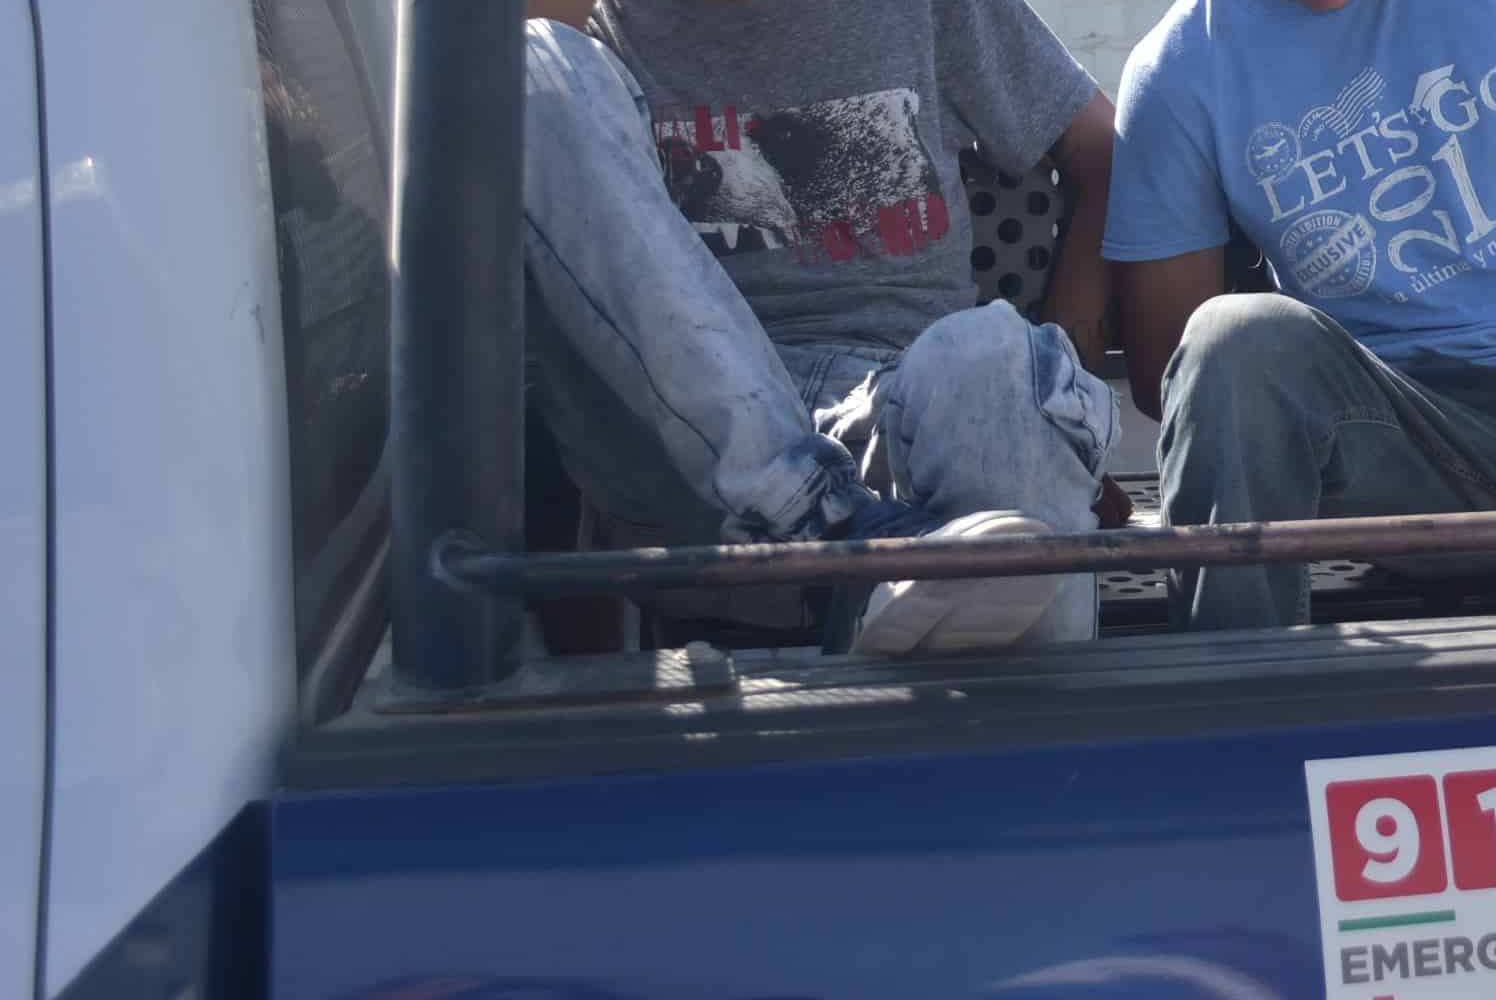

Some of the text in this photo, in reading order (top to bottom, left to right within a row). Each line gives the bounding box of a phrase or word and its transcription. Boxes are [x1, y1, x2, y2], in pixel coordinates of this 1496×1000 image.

[1257, 111, 1418, 223] LET'S
[1298, 222, 1367, 283] CLUSIVE
[1472, 248, 1488, 269] y
